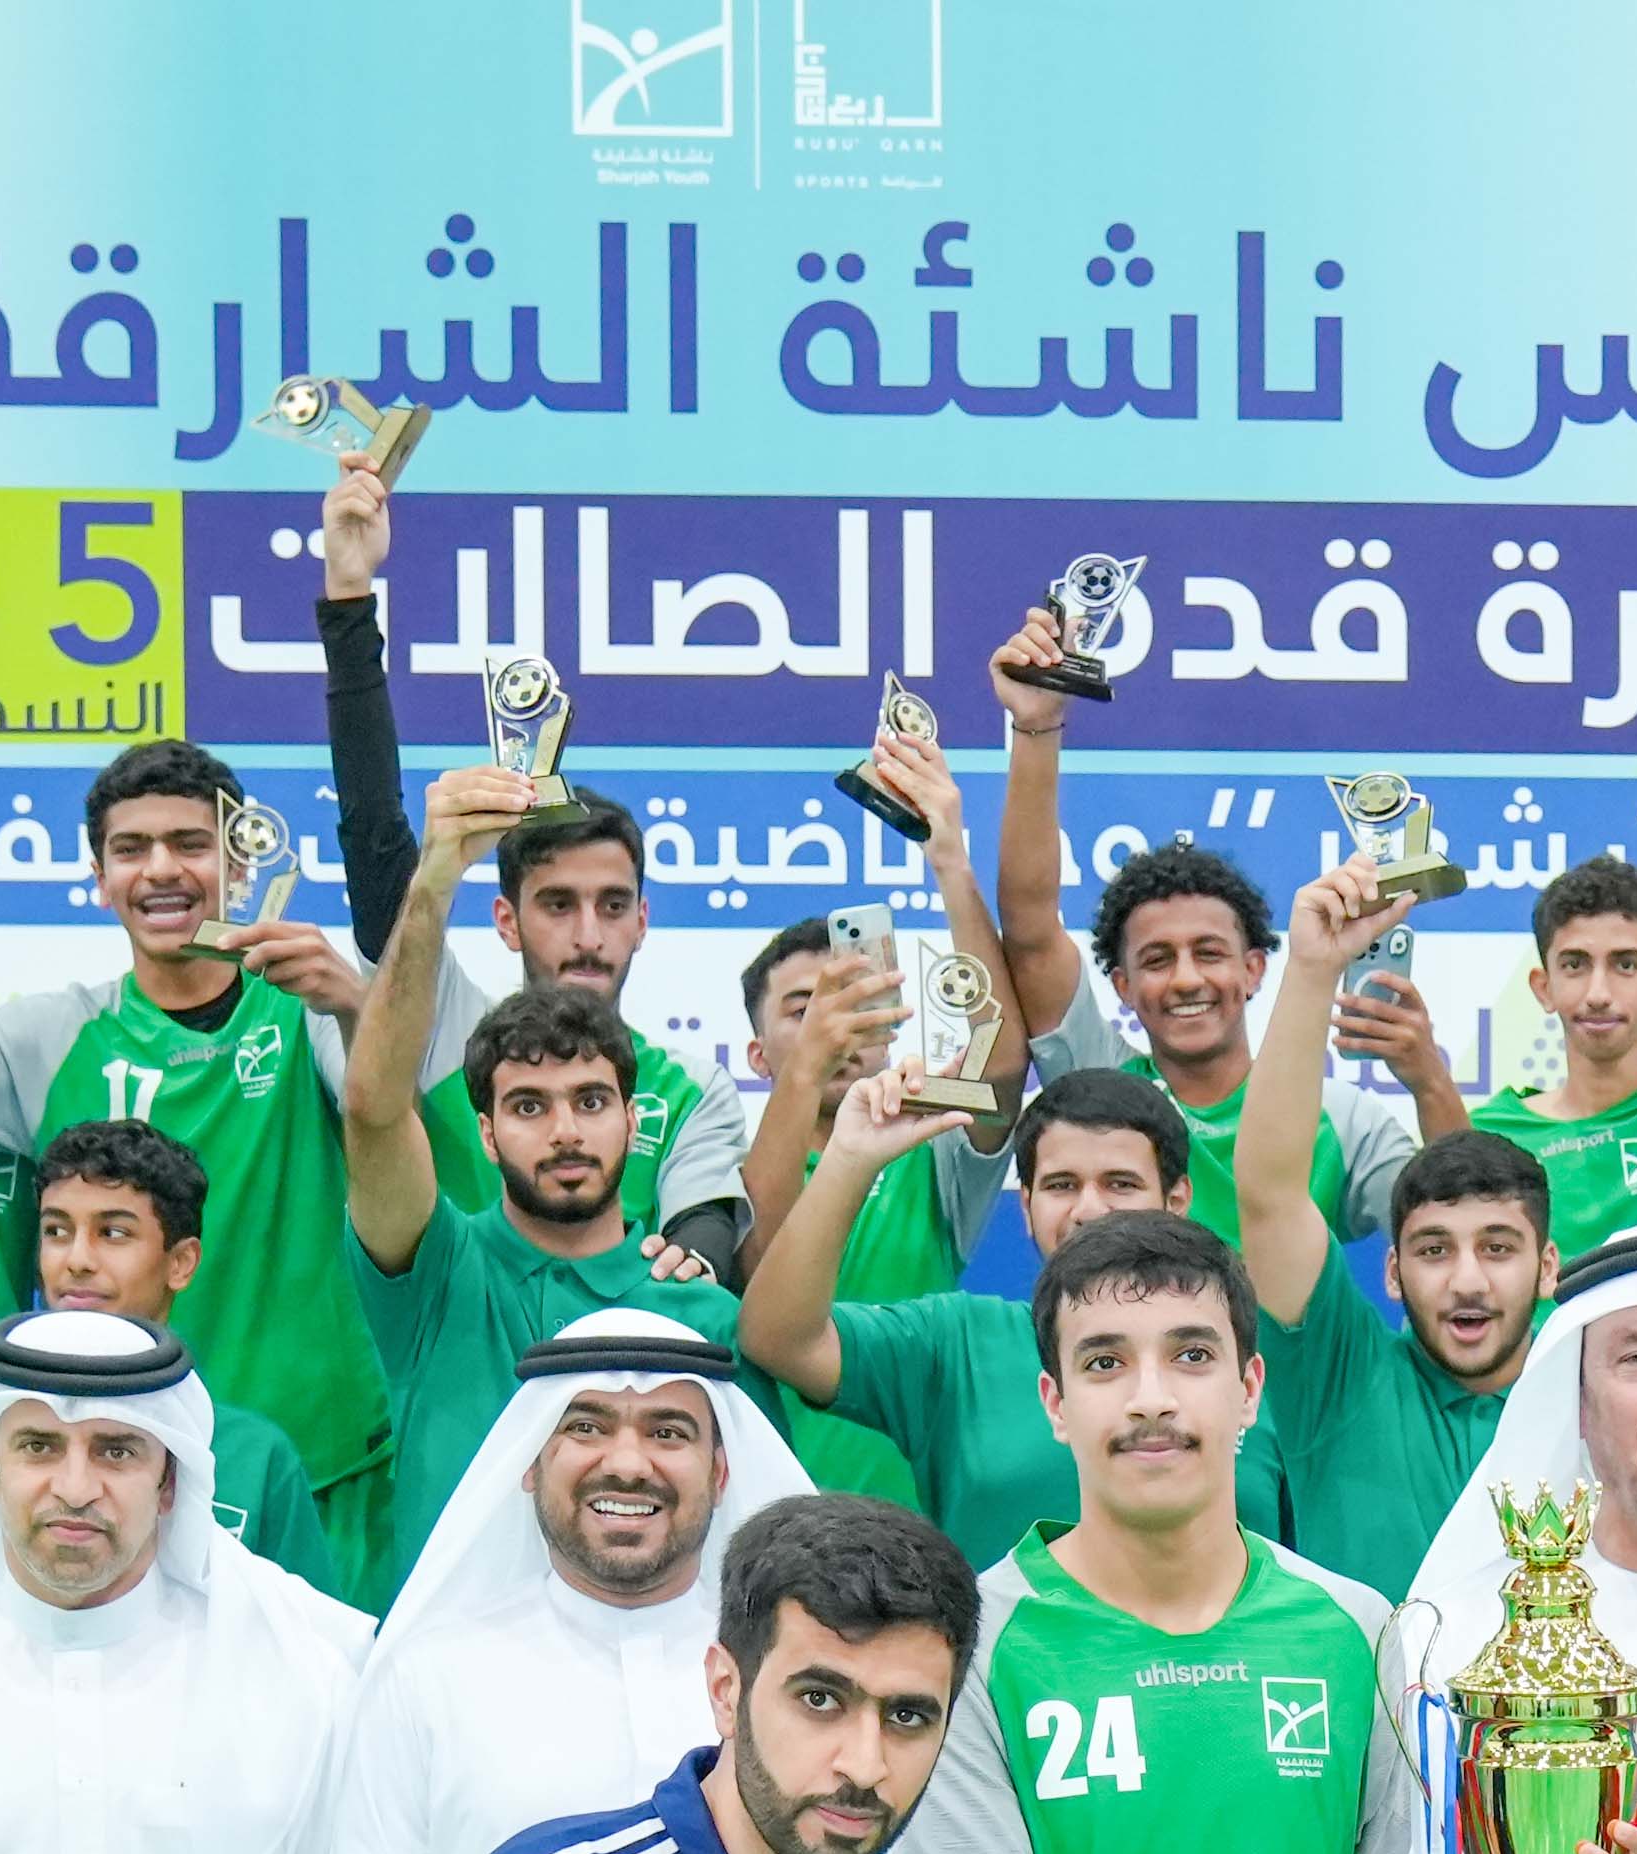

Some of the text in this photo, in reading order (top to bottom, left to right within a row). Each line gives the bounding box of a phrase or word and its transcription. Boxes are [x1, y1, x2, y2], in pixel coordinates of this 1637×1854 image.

[880, 138, 944, 152] QARN
[663, 170, 710, 185] Youth
[779, 220, 1345, 421] ناشئة
[101, 1058, 164, 1124] 17
[1135, 1660, 1250, 1690] uhlsport
[1025, 1694, 1147, 1802] 24
